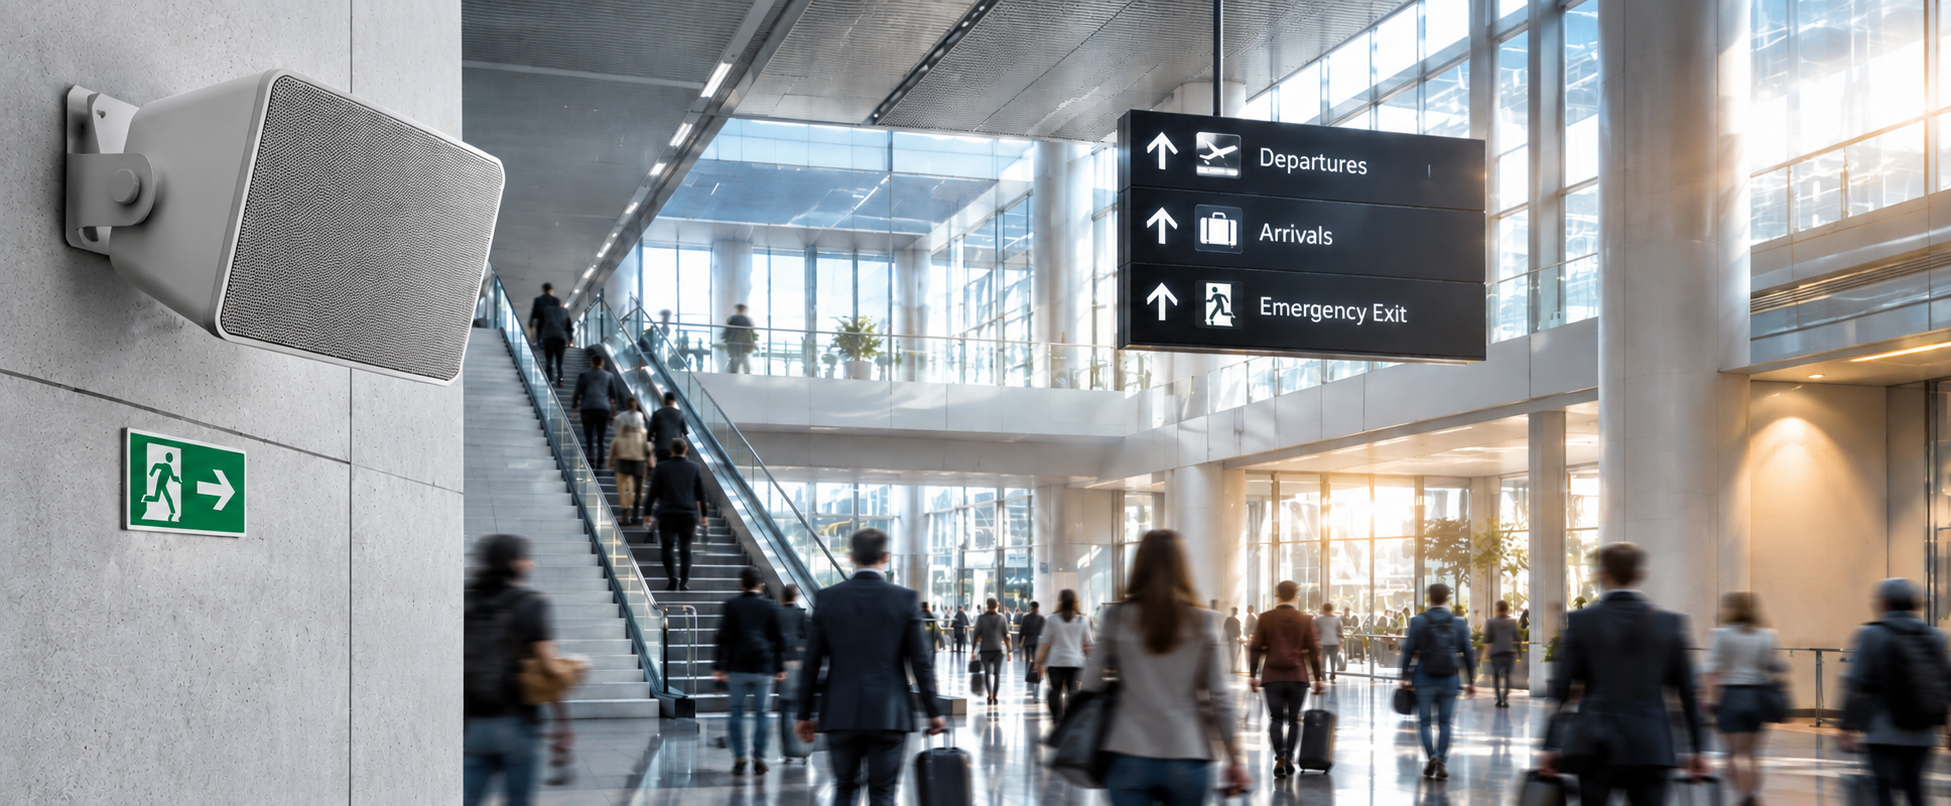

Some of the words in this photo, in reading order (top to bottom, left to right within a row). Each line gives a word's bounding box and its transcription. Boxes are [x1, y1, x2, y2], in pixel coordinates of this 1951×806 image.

[1260, 147, 1368, 175] Departures
[1259, 222, 1333, 246] Arrivals
[1260, 296, 1367, 326] Emergency
[1373, 303, 1408, 324] Exit
